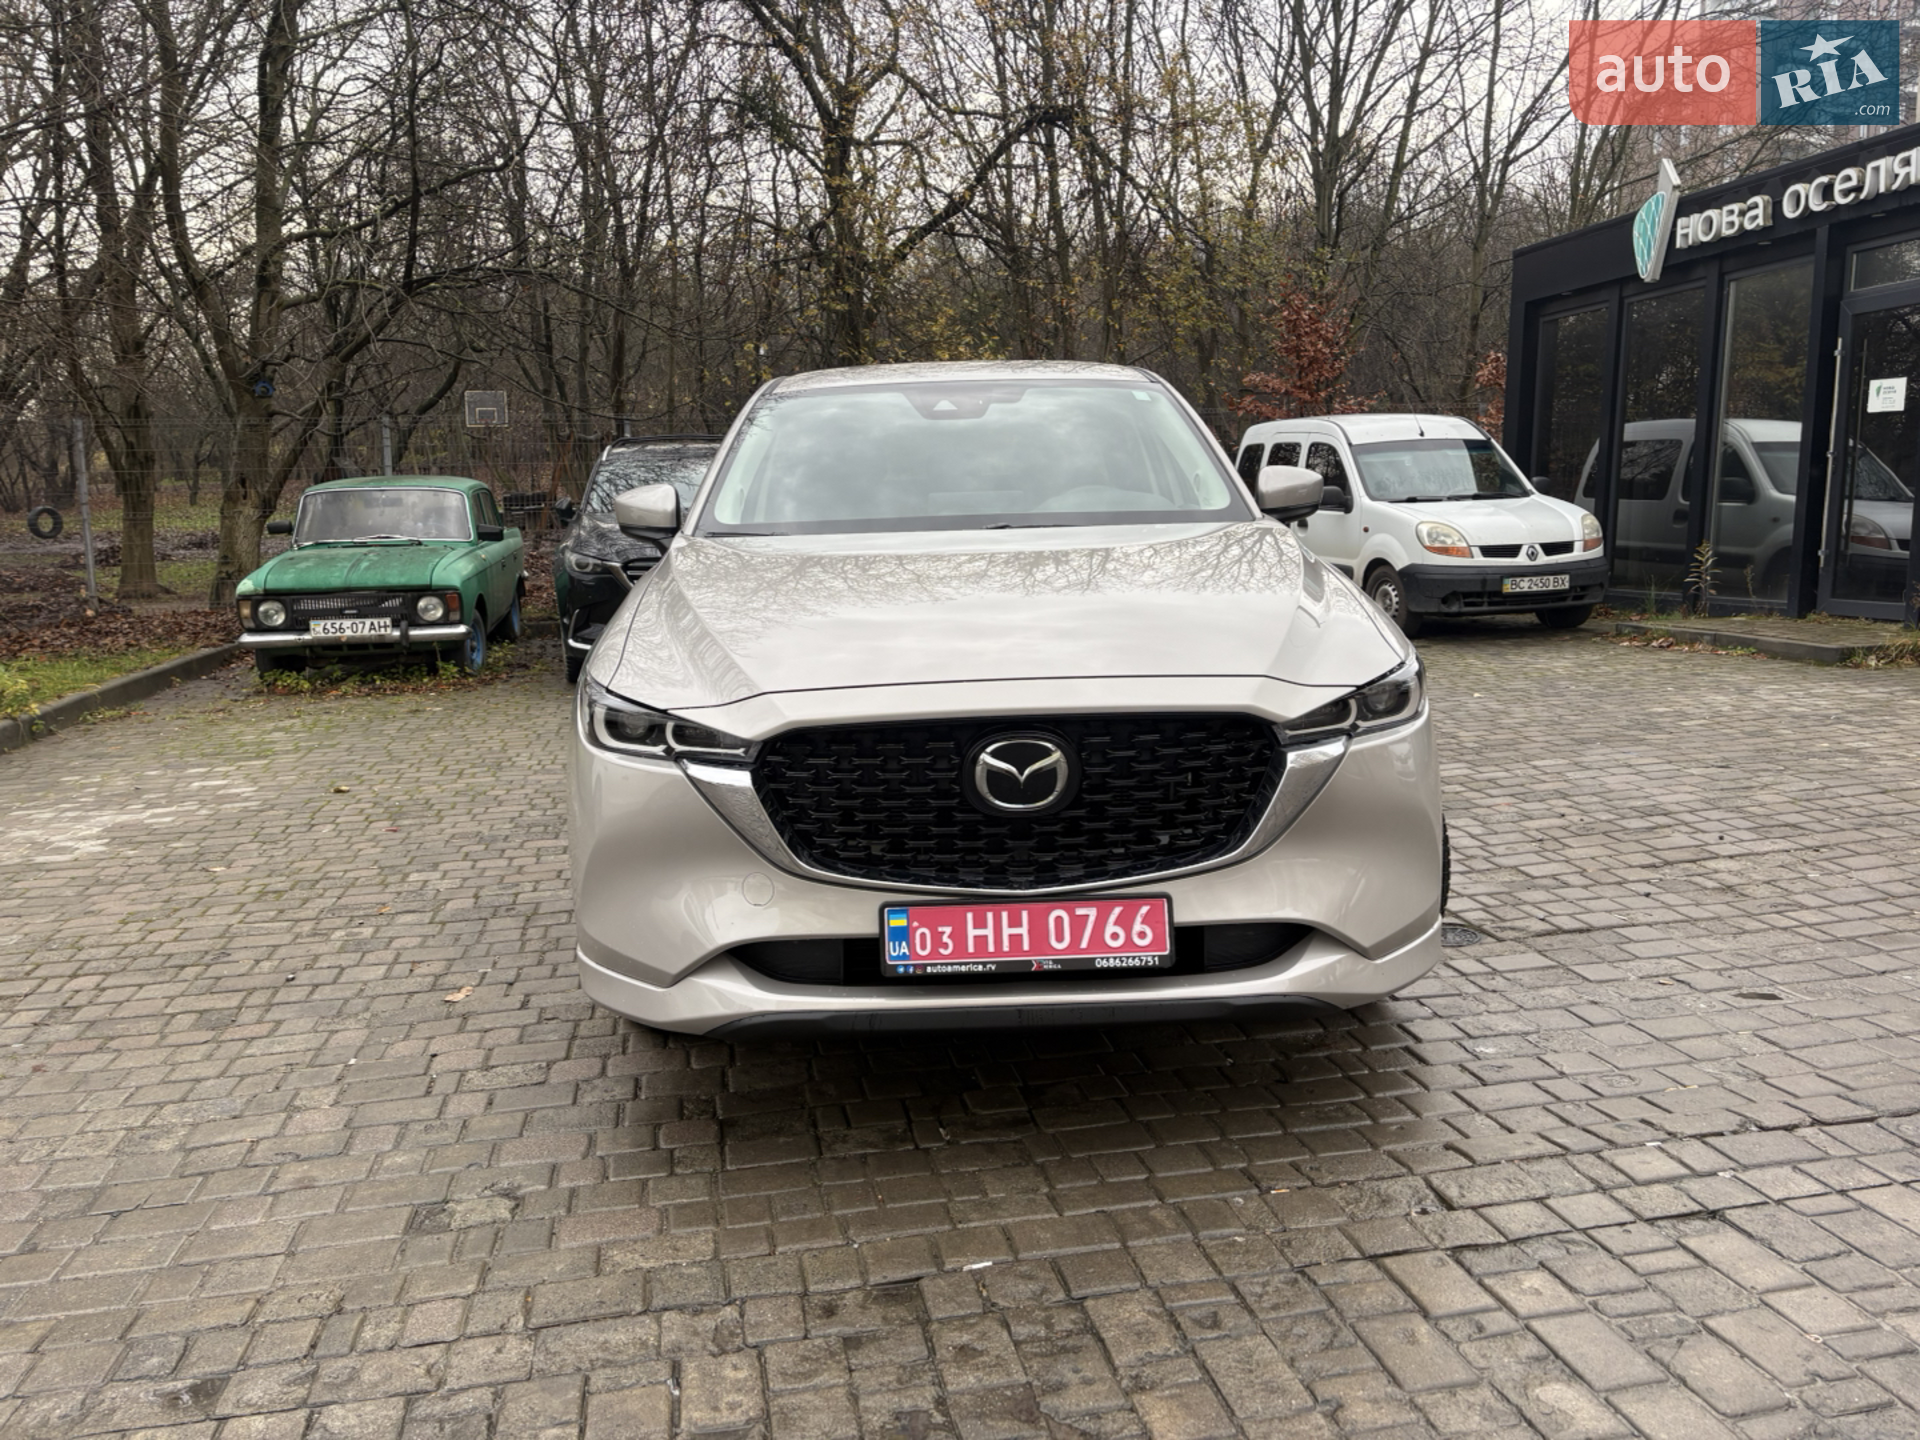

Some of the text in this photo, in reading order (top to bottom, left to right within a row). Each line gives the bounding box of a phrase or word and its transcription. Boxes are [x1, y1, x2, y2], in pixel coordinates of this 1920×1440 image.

[1782, 147, 1920, 219] оселя
[1510, 576, 1567, 590] BC 2450 BX
[322, 621, 366, 634] 656-07
[914, 905, 1154, 957] 03 HH 0766
[889, 941, 910, 957] UA
[926, 963, 997, 973] autoamerica.rv
[1095, 956, 1159, 967] 0686266751
